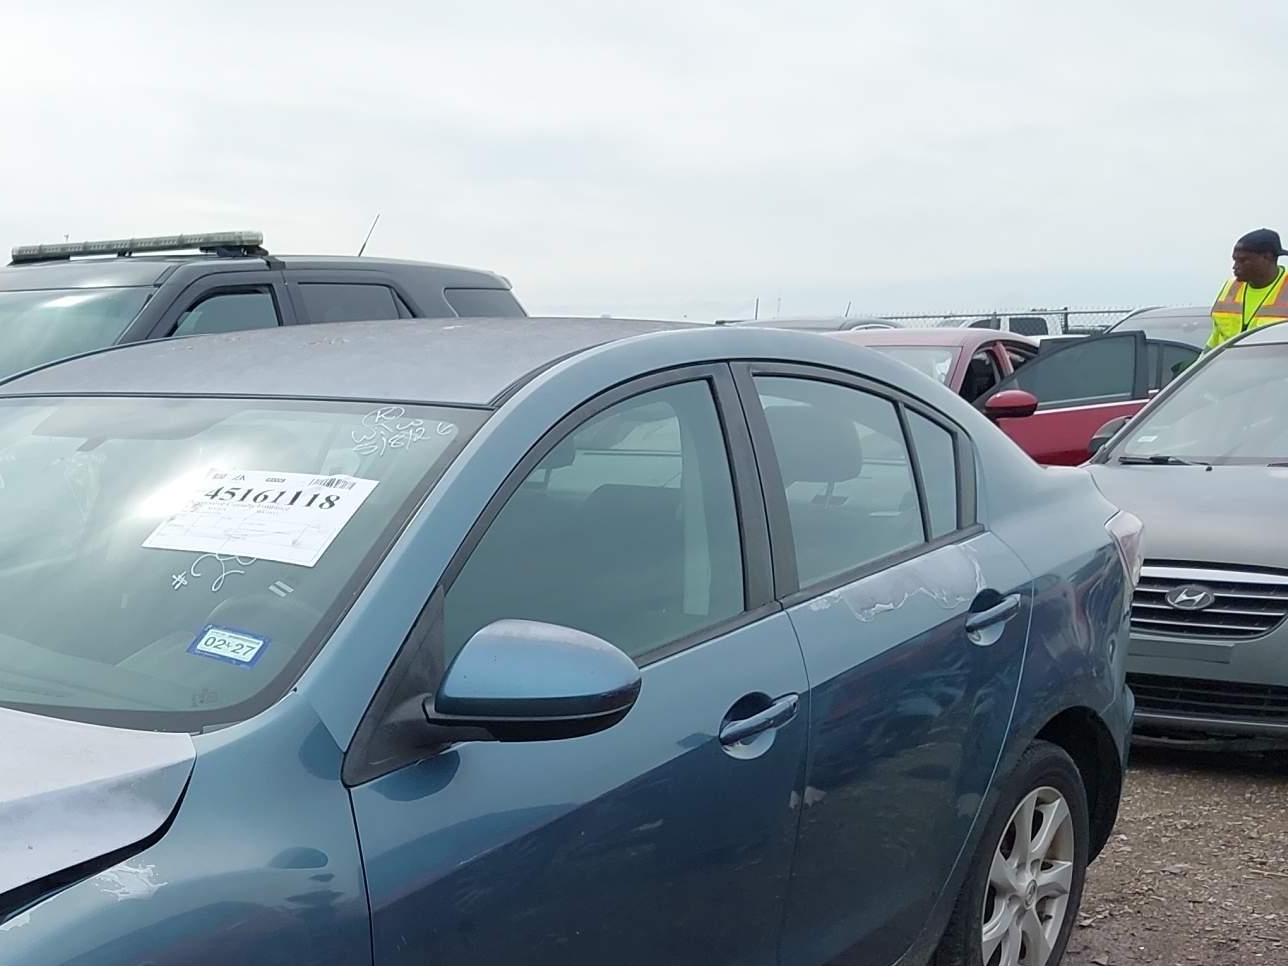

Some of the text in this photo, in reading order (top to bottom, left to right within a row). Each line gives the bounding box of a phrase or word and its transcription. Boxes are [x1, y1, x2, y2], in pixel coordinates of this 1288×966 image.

[205, 485, 341, 510] 45161118
[203, 636, 226, 650] 02
[230, 643, 256, 656] 27
